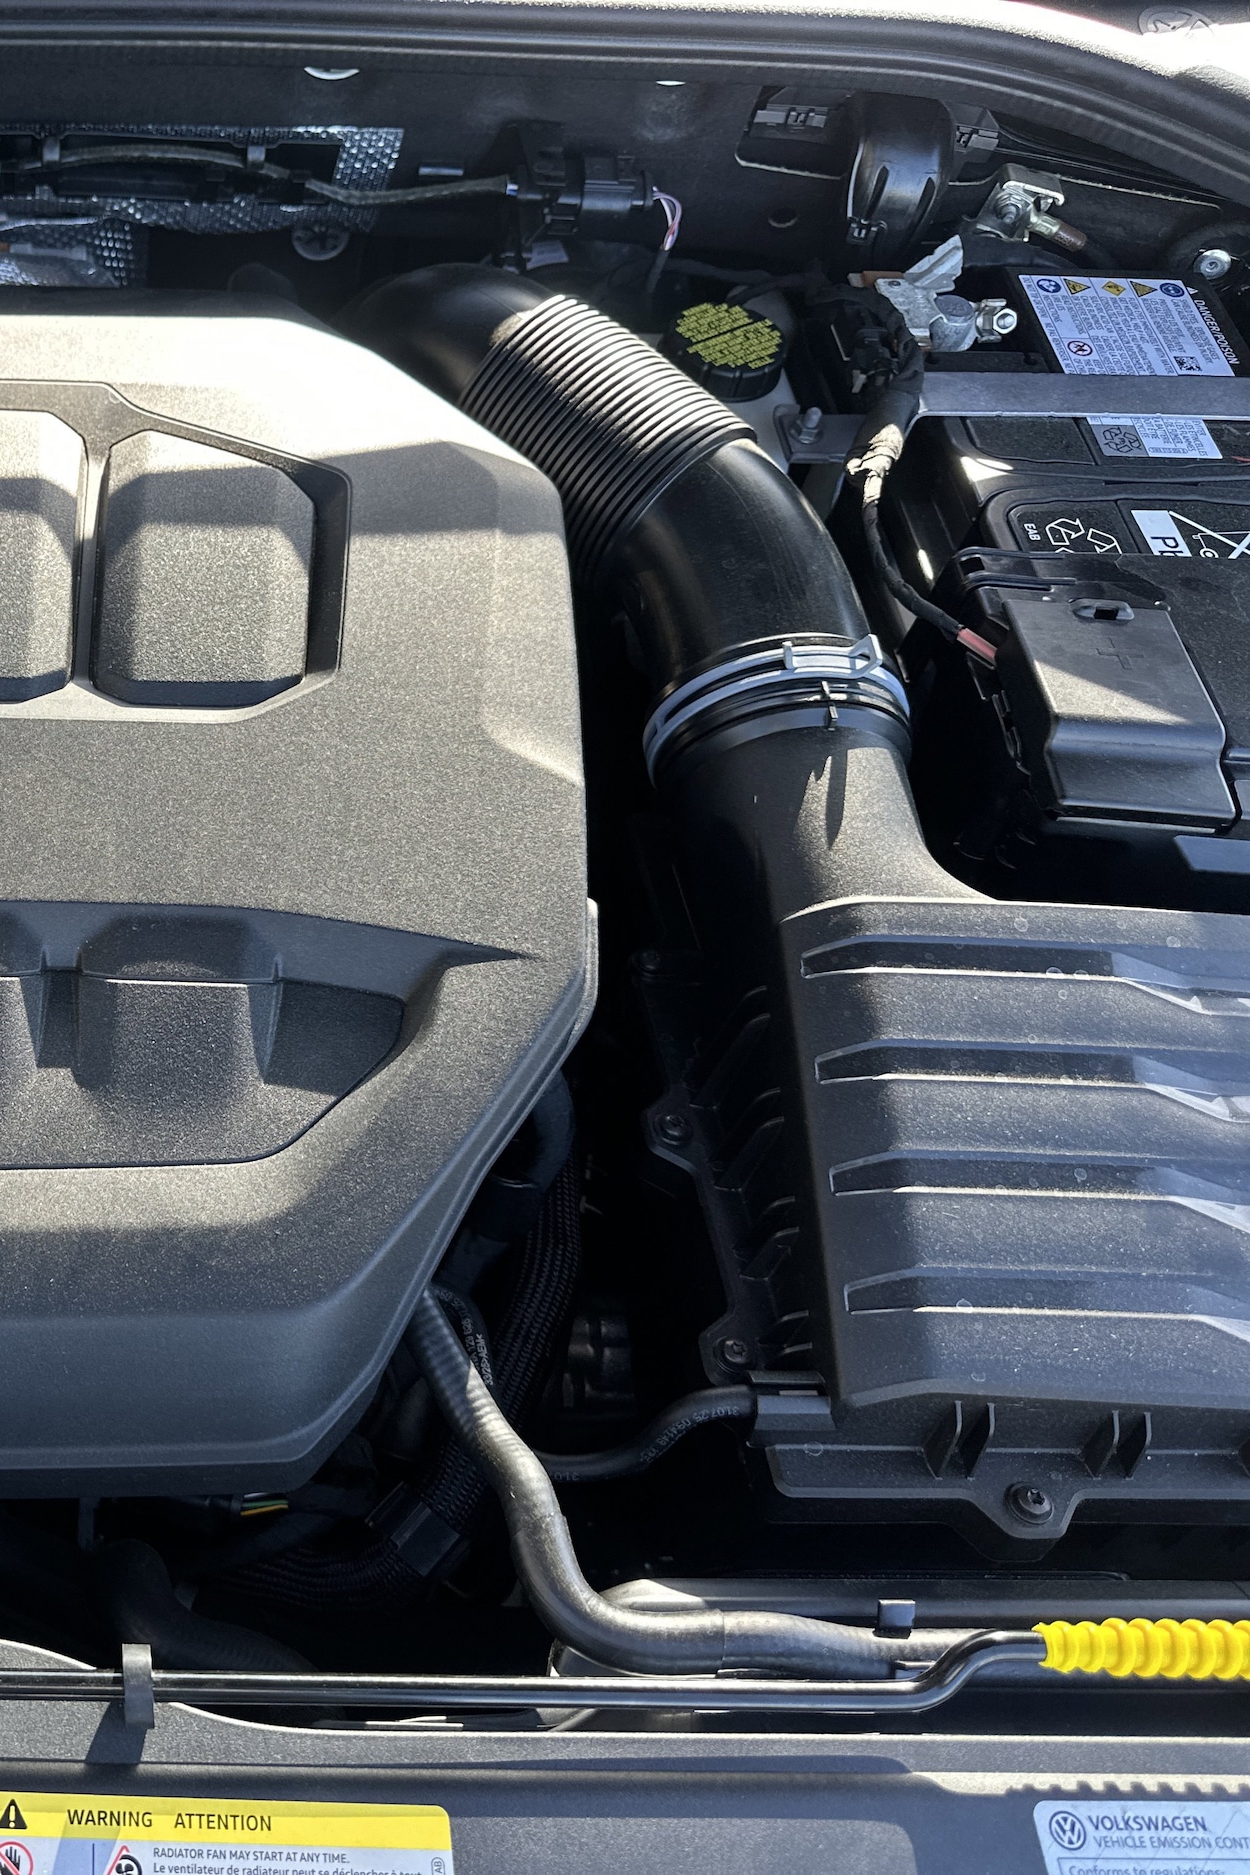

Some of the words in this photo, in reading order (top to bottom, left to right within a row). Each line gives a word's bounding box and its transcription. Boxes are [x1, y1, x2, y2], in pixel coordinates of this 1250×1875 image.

[1196, 299, 1240, 366] DANGER/POISON
[1024, 523, 1041, 540] EAB
[67, 1809, 153, 1827] WARNING
[174, 1812, 272, 1831] ATTENTION
[1088, 1815, 1208, 1832] VOLKSWAGEN
[1093, 1836, 1146, 1849] VEHICLE
[1150, 1836, 1212, 1849] EMISSION
[153, 1847, 204, 1859] RADIATOR
[206, 1849, 227, 1859] FAN
[230, 1850, 251, 1860] MAY
[253, 1850, 283, 1861] START
[285, 1851, 298, 1862] AT
[300, 1852, 320, 1863] ANY
[322, 1853, 350, 1864] TIME.
[153, 1862, 166, 1873] Le
[168, 1863, 224, 1875] ventilateur
[227, 1864, 240, 1875] de
[242, 1865, 290, 1875] radiateur
[1069, 1865, 1132, 1875] Conforms
[1133, 1867, 1148, 1875] to
